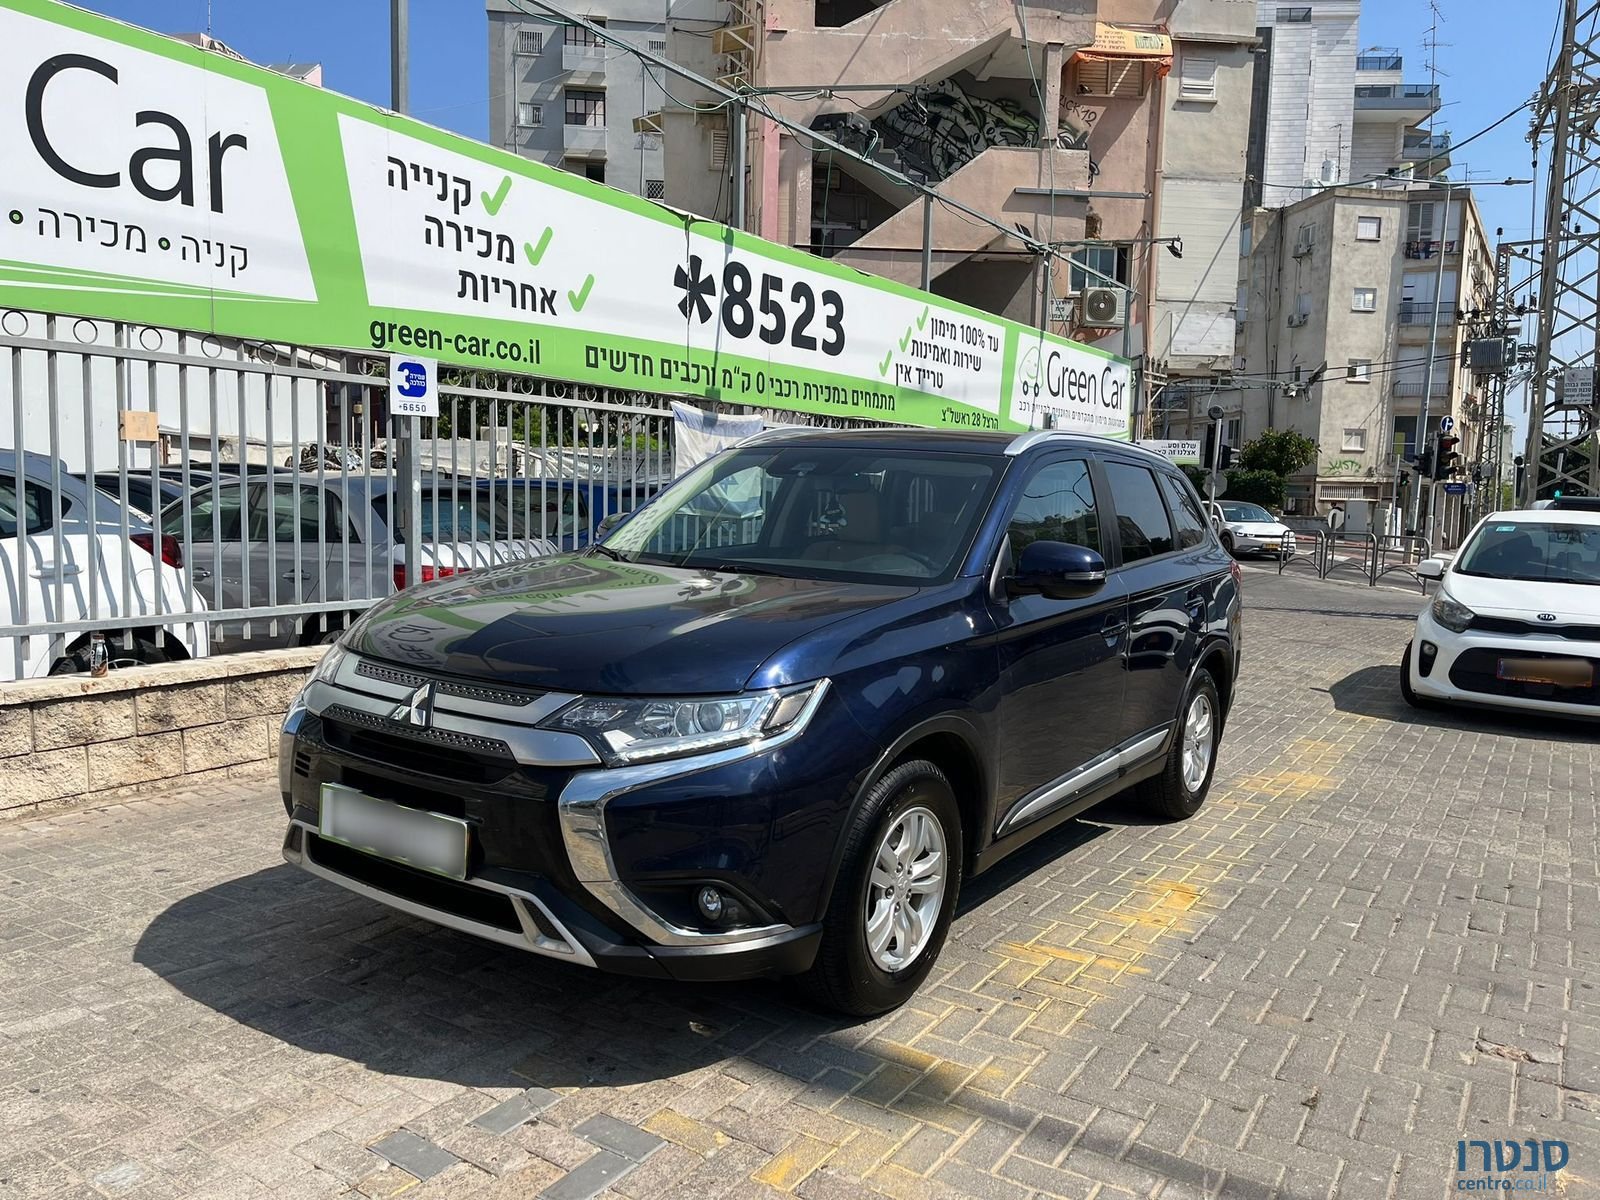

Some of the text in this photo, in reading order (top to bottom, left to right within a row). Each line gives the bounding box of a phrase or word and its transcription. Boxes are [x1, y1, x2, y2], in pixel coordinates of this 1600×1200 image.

[24, 53, 248, 214] Car
[386, 155, 472, 215] קנייה
[37, 207, 249, 278] קניה מכירה
[424, 214, 515, 265] מכירה
[457, 269, 558, 316] אחריות
[369, 319, 541, 364] green-car.co.il
[930, 317, 999, 352] עד 100% מימון
[585, 345, 654, 378] חדשים
[911, 339, 982, 372] שירות ואמינות
[660, 357, 716, 388] ורכבים
[756, 371, 766, 394] 0
[769, 376, 800, 400] רכבי
[895, 361, 944, 389] טרייד אין
[1046, 350, 1125, 410] Green Car
[802, 381, 848, 405] במכירת
[850, 388, 896, 411] מתמחים
[971, 412, 981, 427] 28
[982, 413, 999, 430] הרצל
